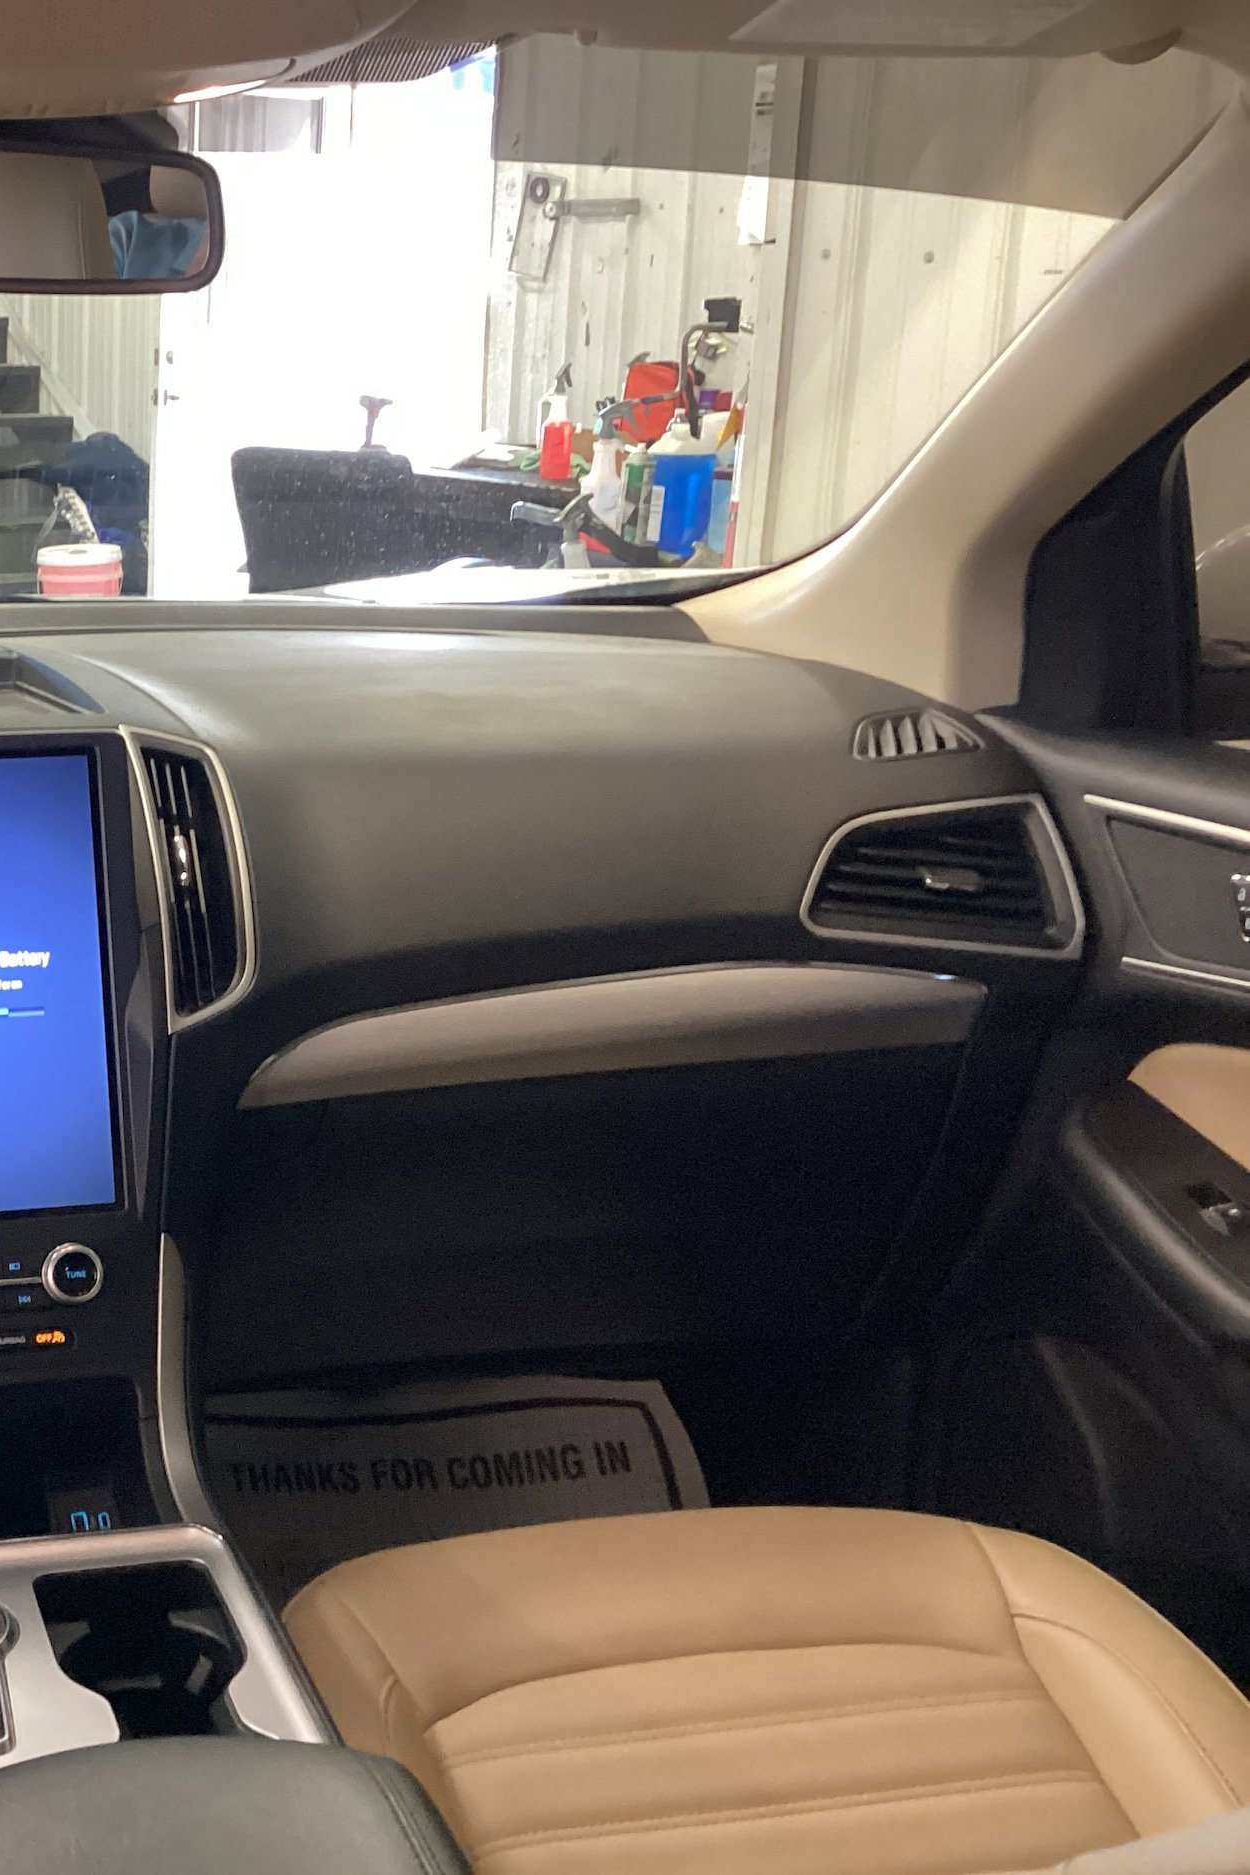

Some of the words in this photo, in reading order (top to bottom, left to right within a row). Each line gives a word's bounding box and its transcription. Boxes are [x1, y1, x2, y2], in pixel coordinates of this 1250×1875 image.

[0, 951, 50, 968] Battery
[66, 1269, 86, 1280] TUNE
[36, 1333, 52, 1344] OFF
[228, 1460, 361, 1494] THANKS
[369, 1458, 439, 1492] FOR
[447, 1443, 586, 1490] COMING
[591, 1440, 632, 1475] IN
